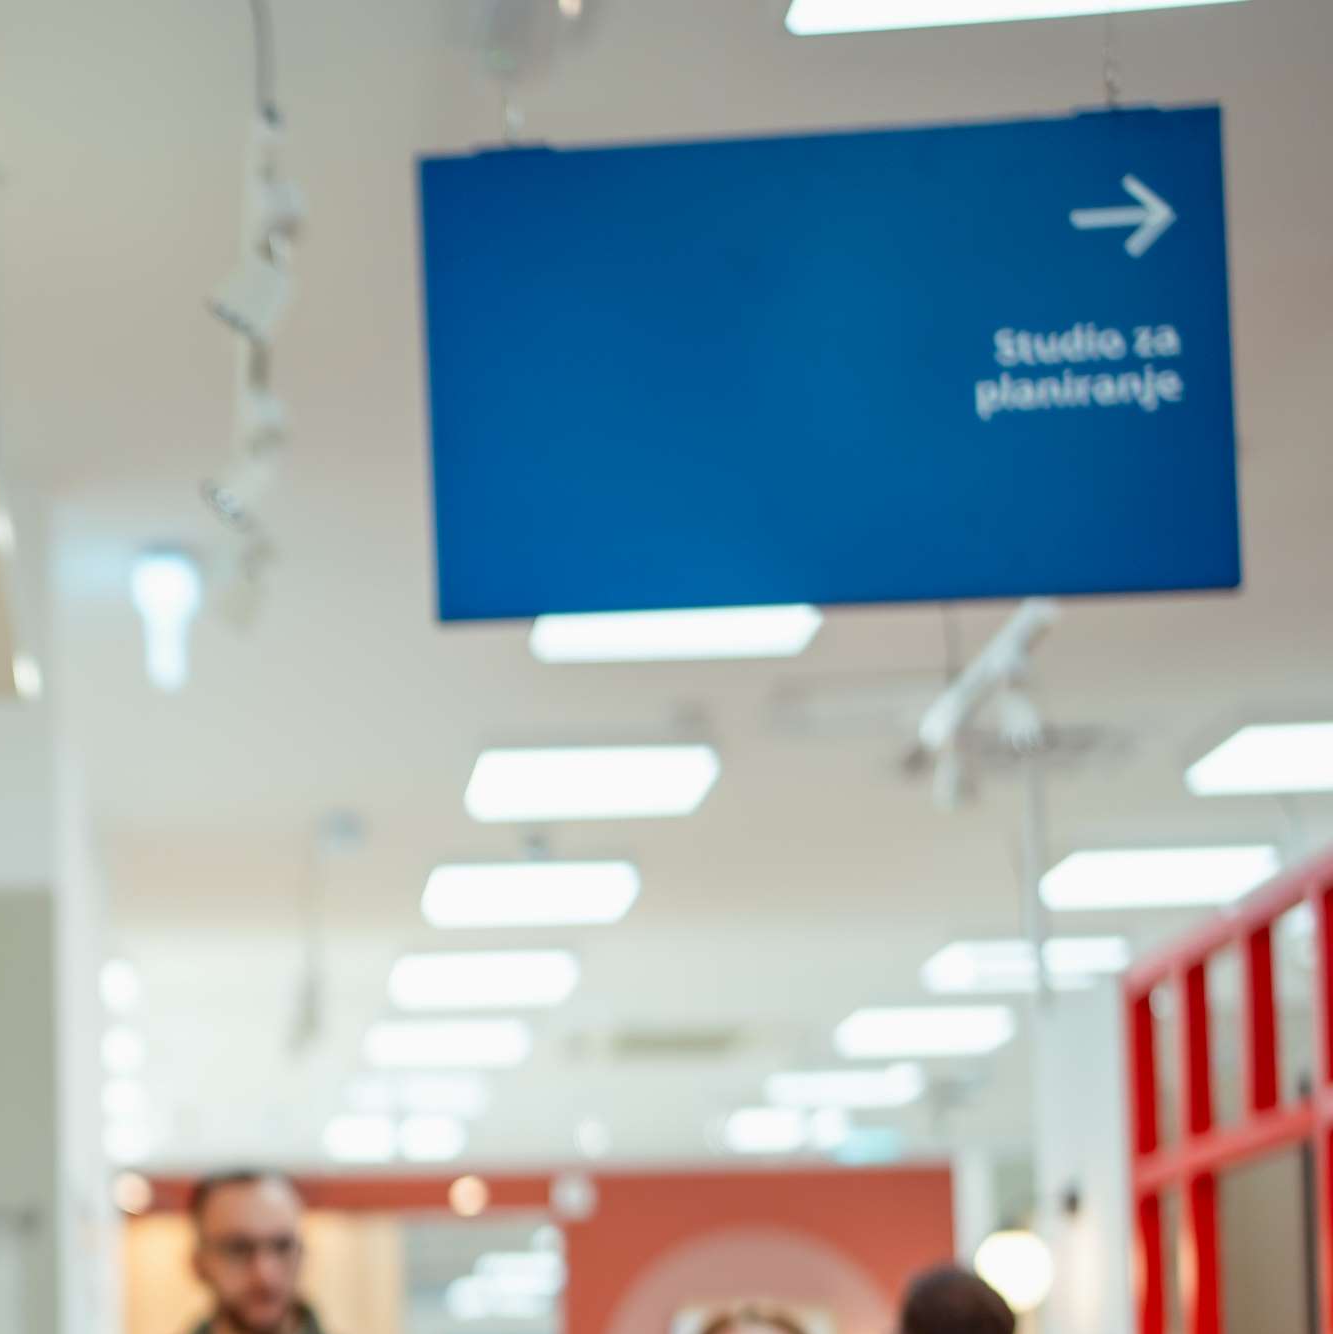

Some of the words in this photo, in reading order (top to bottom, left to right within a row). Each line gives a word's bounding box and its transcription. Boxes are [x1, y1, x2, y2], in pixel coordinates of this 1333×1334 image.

[993, 321, 1127, 366] Studio
[1133, 324, 1181, 358] za
[975, 363, 1184, 421] planiranje
